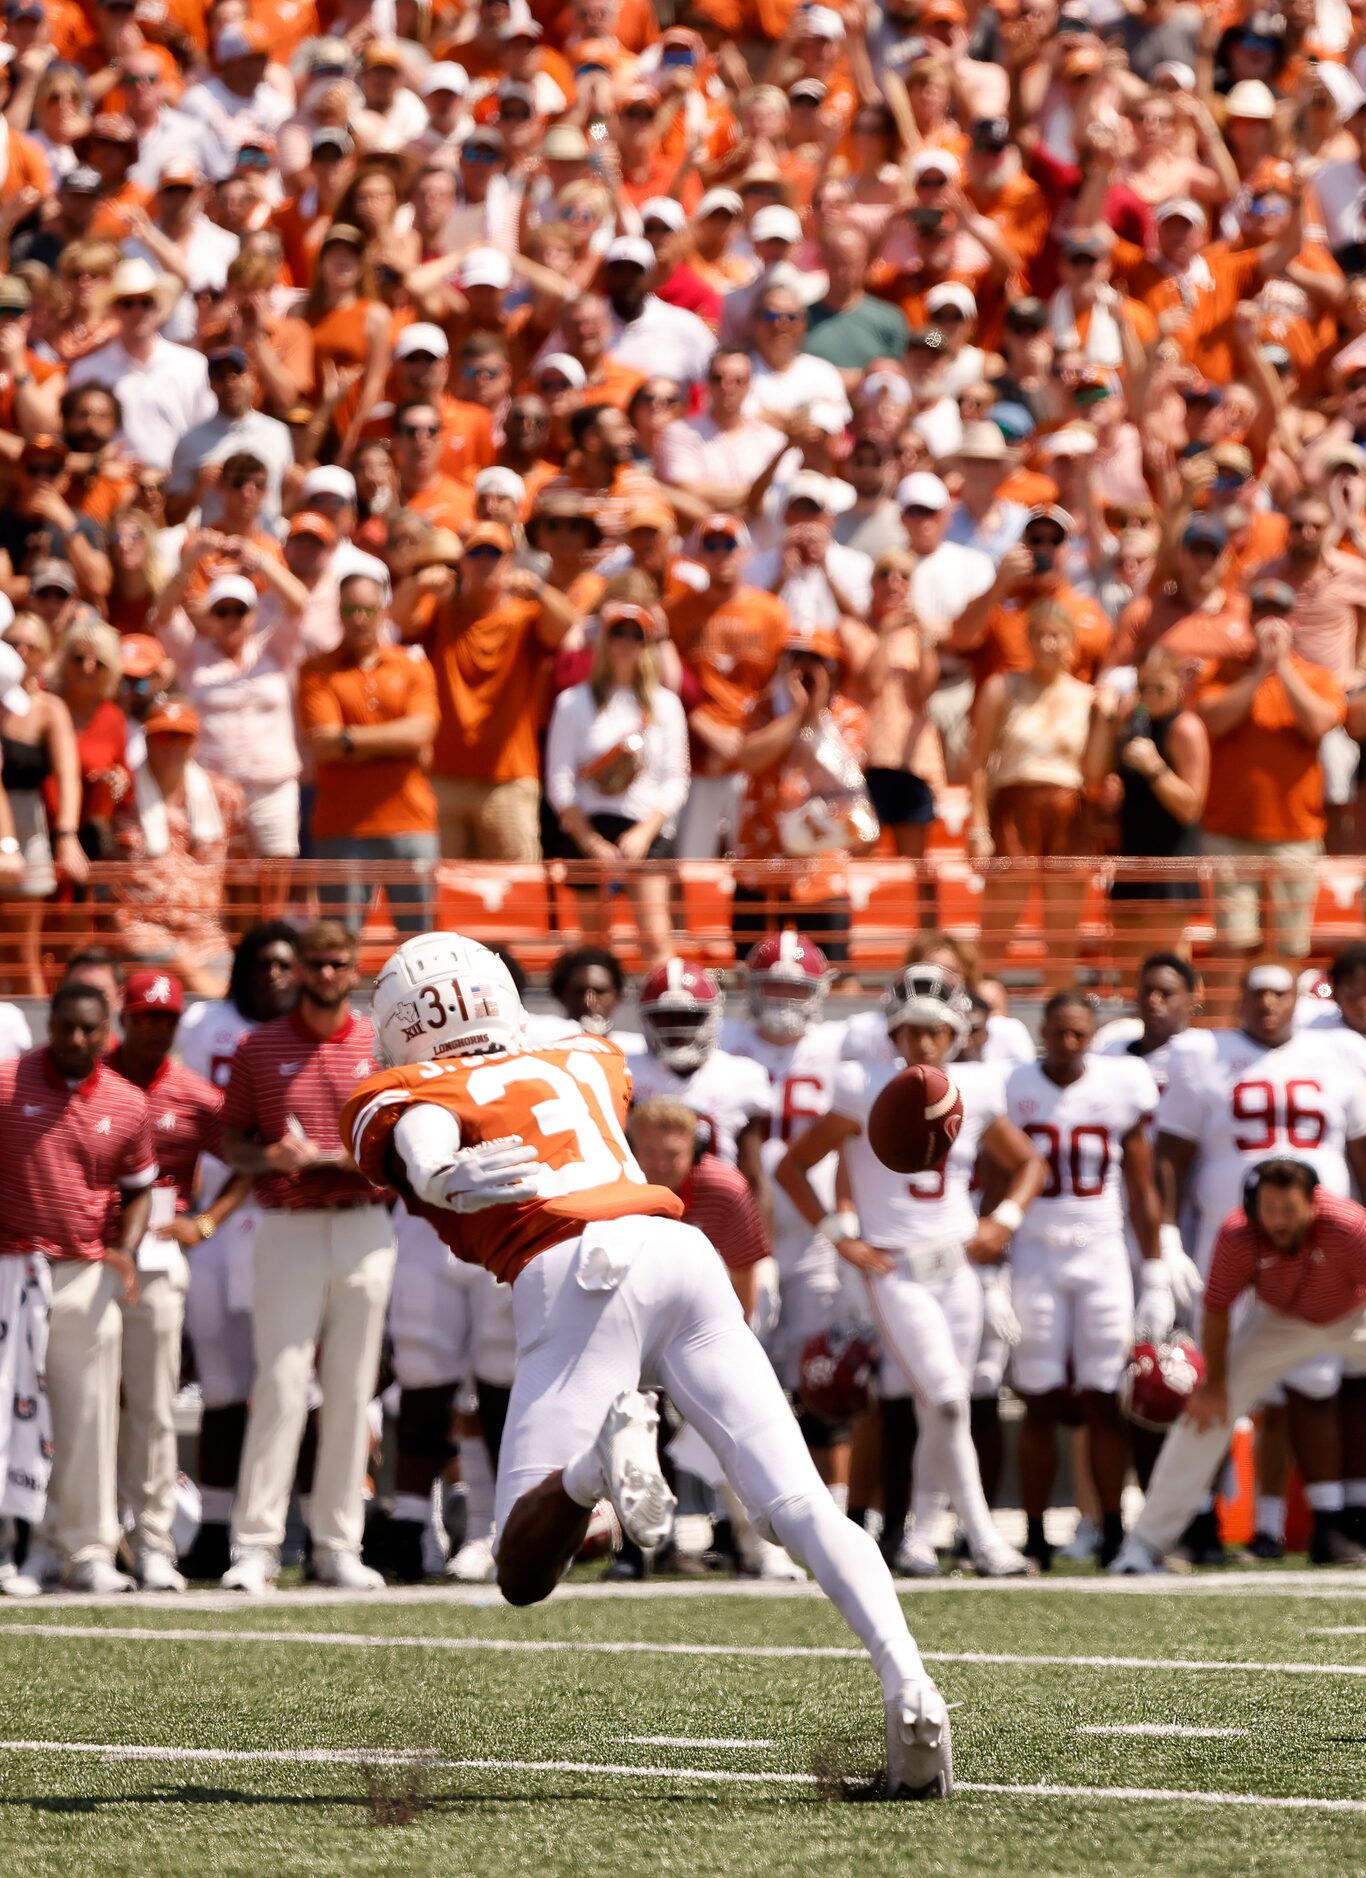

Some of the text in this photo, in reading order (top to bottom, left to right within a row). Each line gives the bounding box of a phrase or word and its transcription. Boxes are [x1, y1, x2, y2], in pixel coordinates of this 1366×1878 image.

[420, 978, 469, 1029] 31
[401, 1020, 427, 1042] XII
[433, 1033, 489, 1056] LONGHORNS
[467, 1051, 648, 1198] 31
[1232, 1079, 1327, 1151] 96
